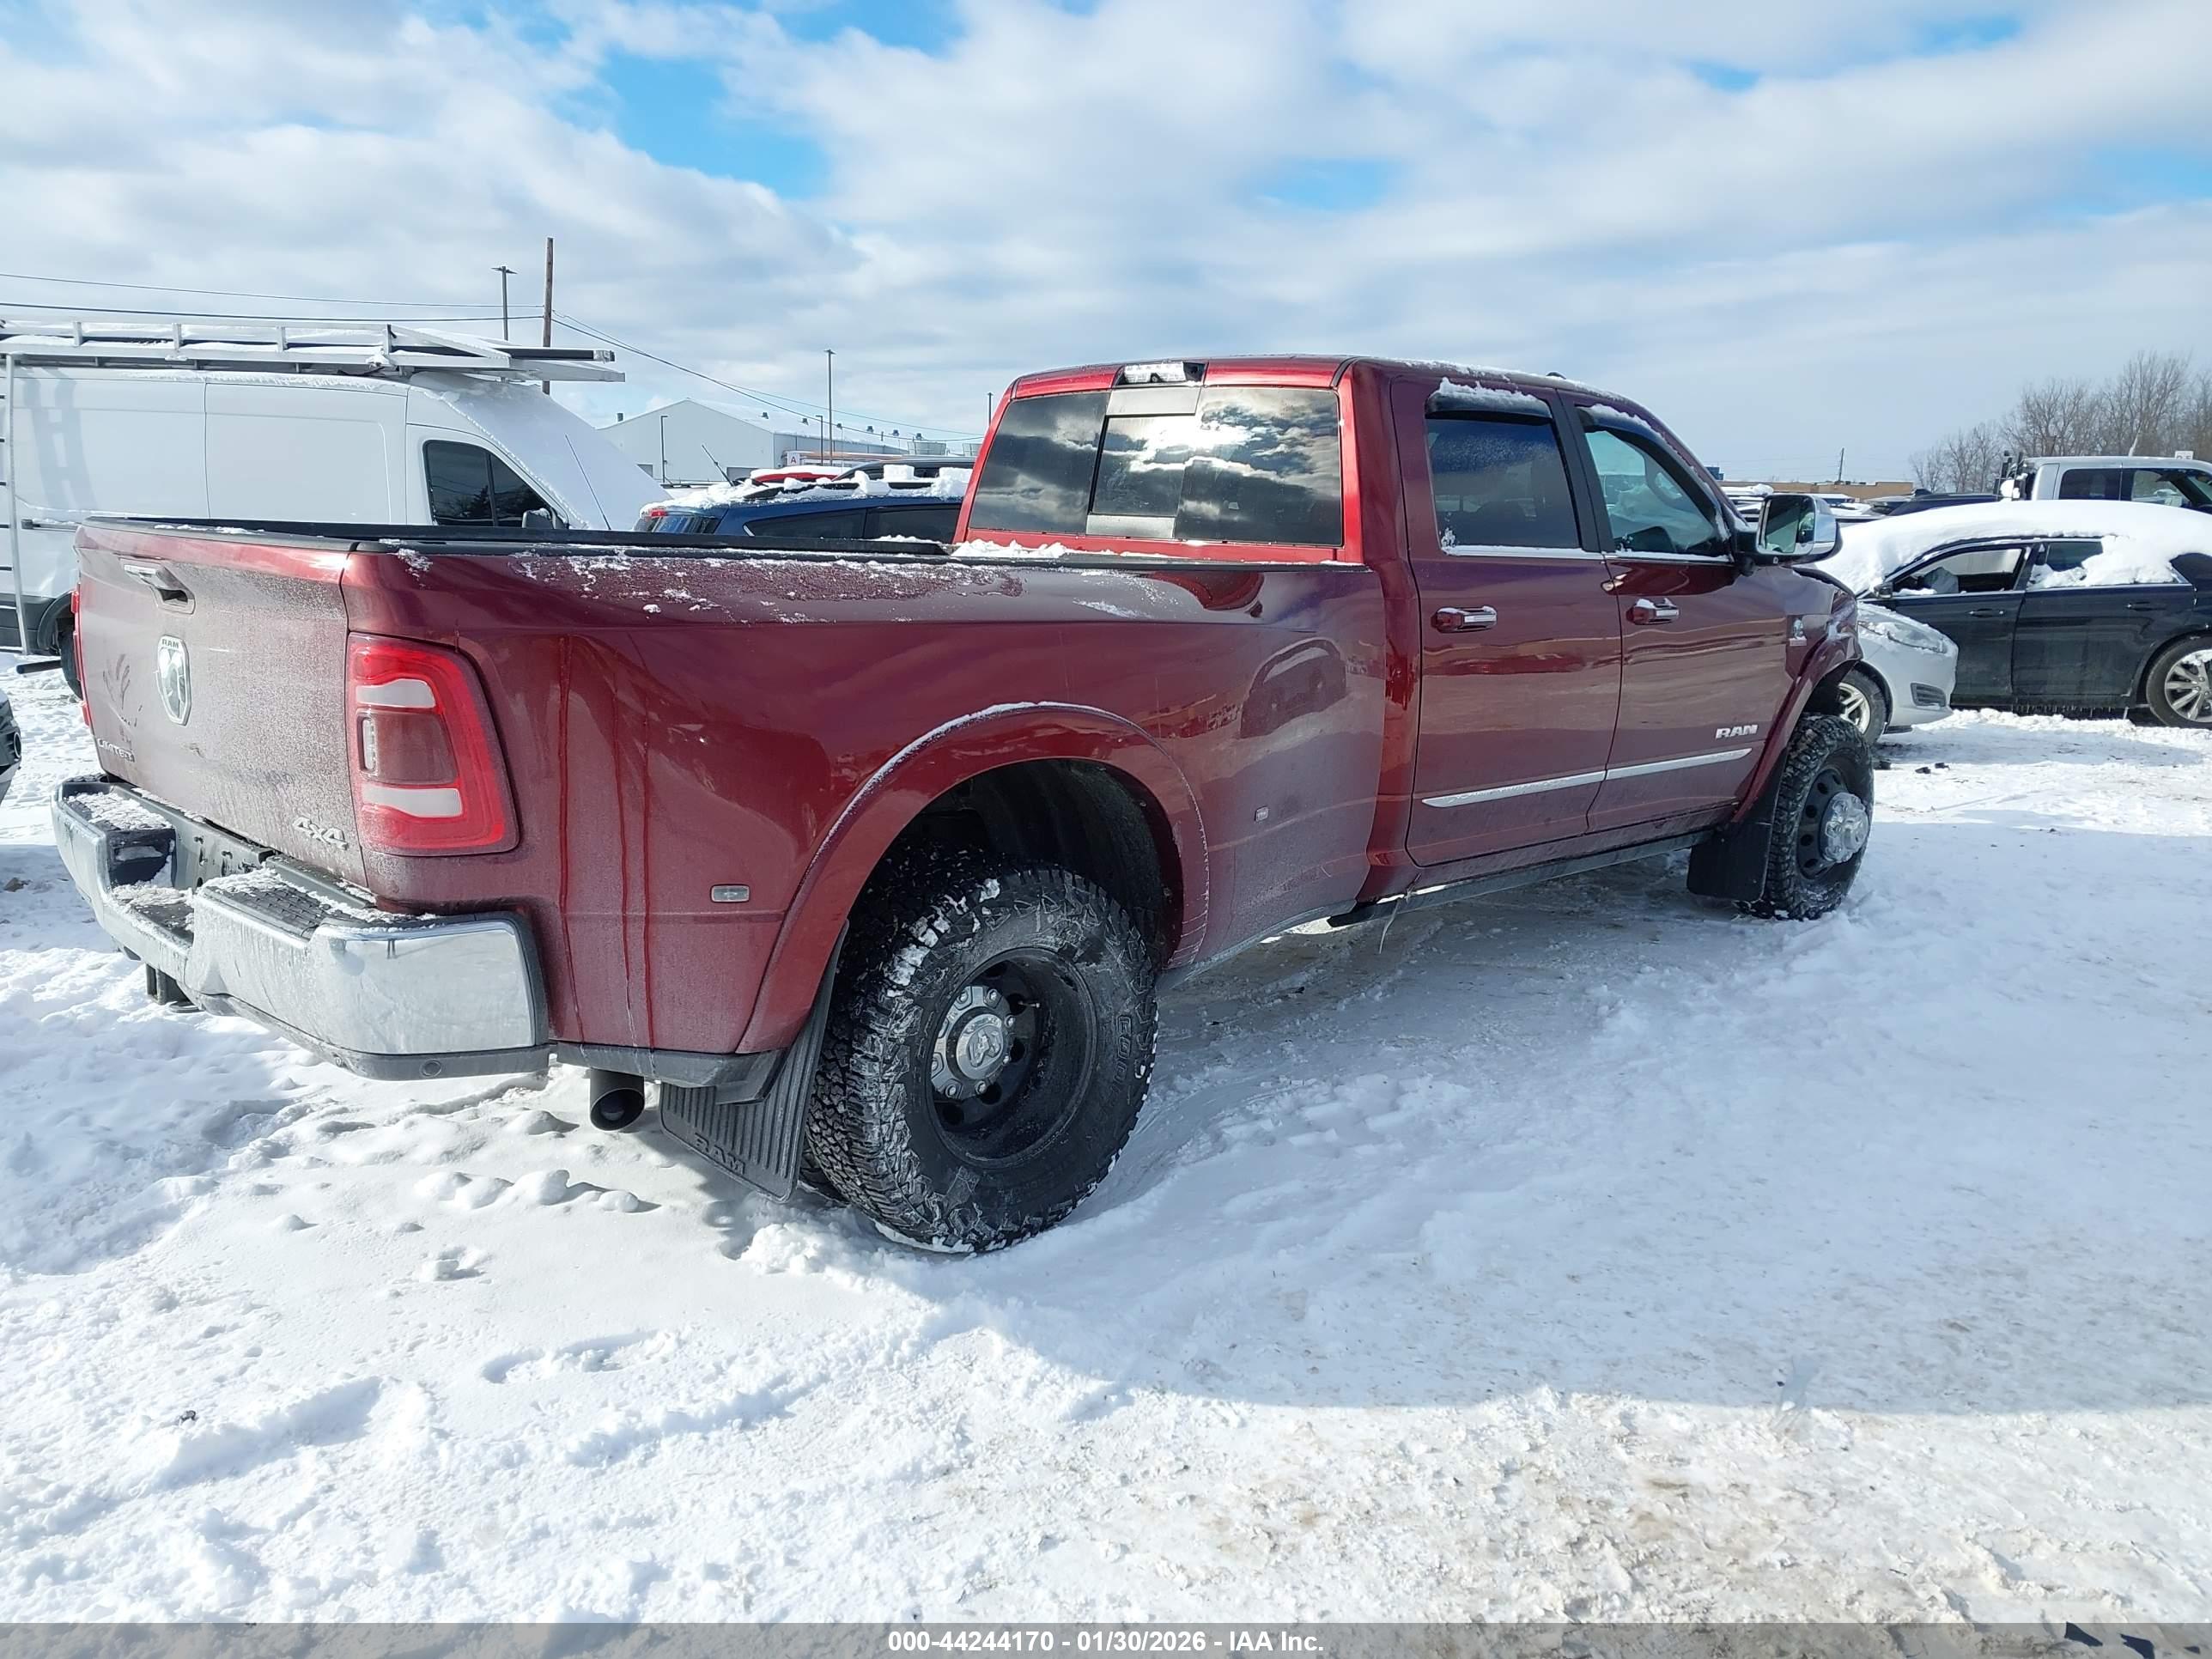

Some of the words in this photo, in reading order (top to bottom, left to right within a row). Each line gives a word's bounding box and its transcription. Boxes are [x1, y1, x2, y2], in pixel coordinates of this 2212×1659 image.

[161, 638, 179, 649] RAM
[1716, 724, 1759, 739] RAM
[692, 1132, 745, 1176] RAM
